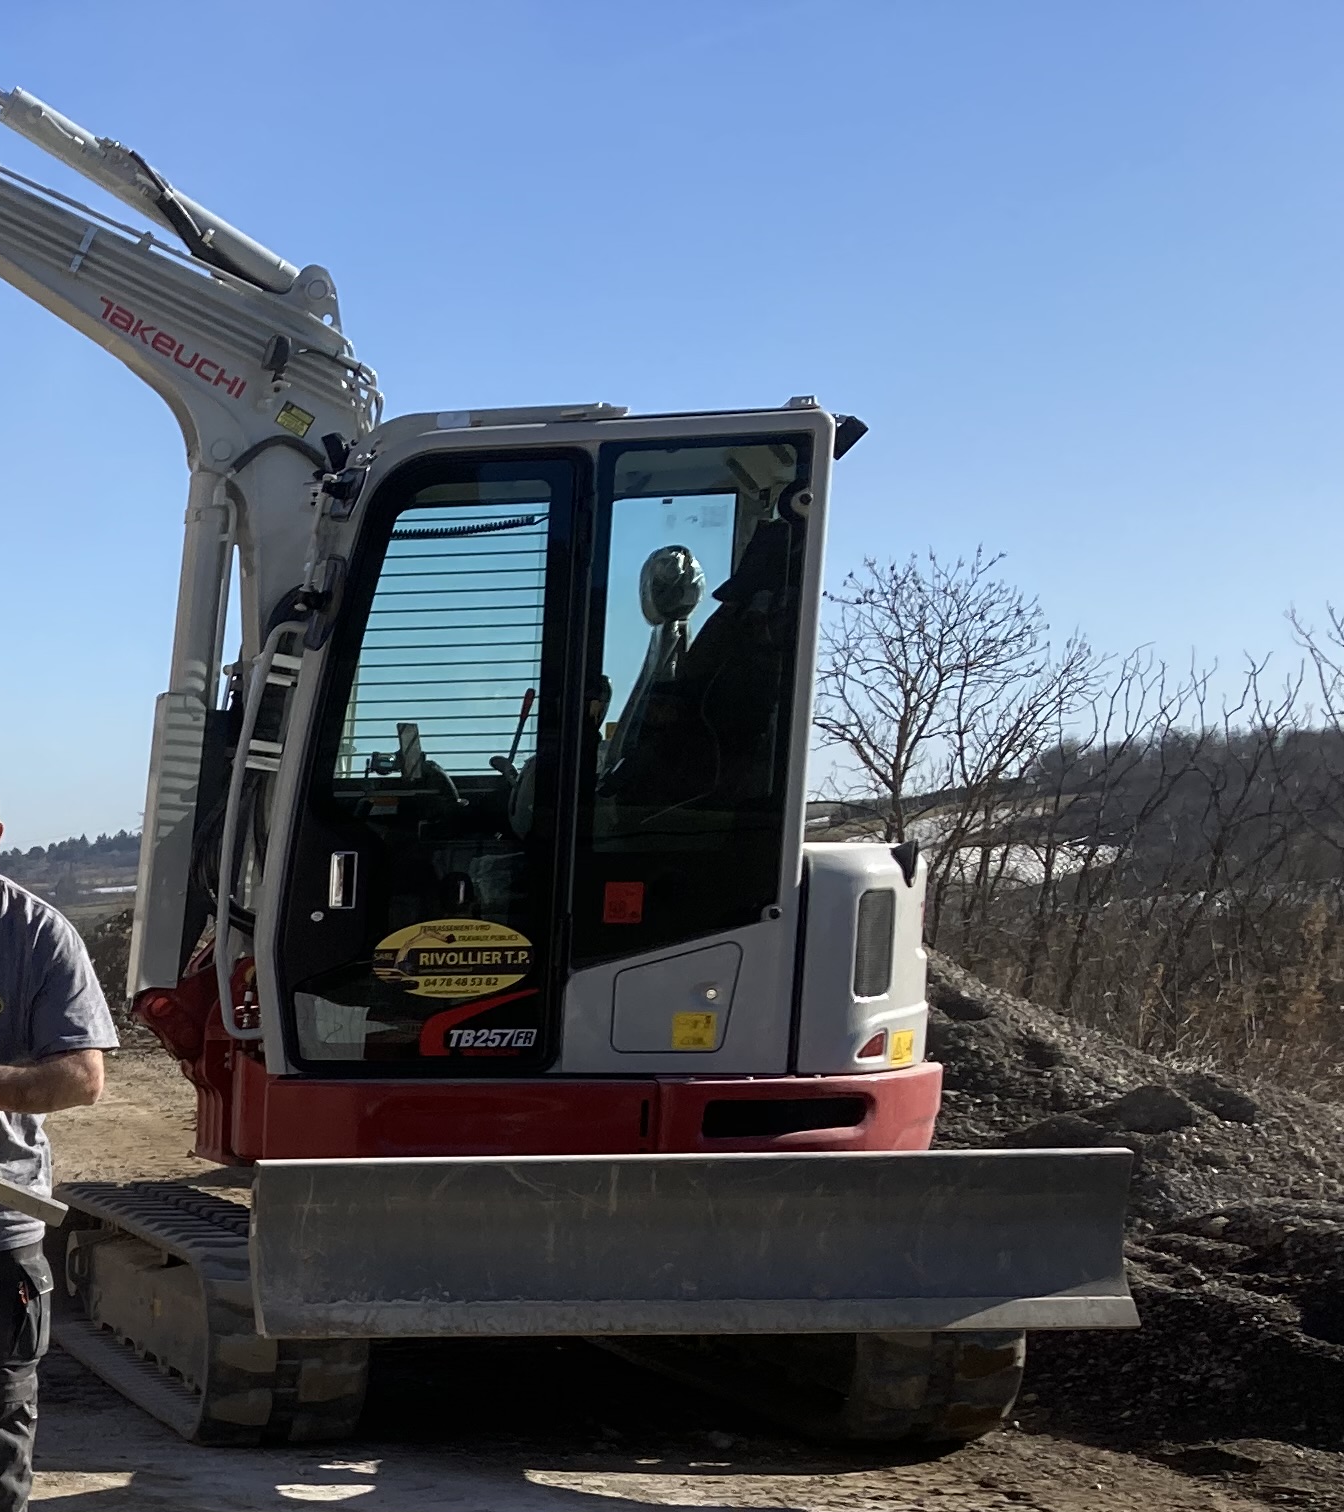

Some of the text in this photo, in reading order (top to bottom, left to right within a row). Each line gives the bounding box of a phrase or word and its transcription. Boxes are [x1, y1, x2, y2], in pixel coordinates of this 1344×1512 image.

[419, 951, 530, 966] RIVOLLIER T.P.
[424, 978, 438, 987] 04
[439, 978, 453, 987] 78
[455, 978, 468, 987] 48
[469, 978, 483, 987] 53
